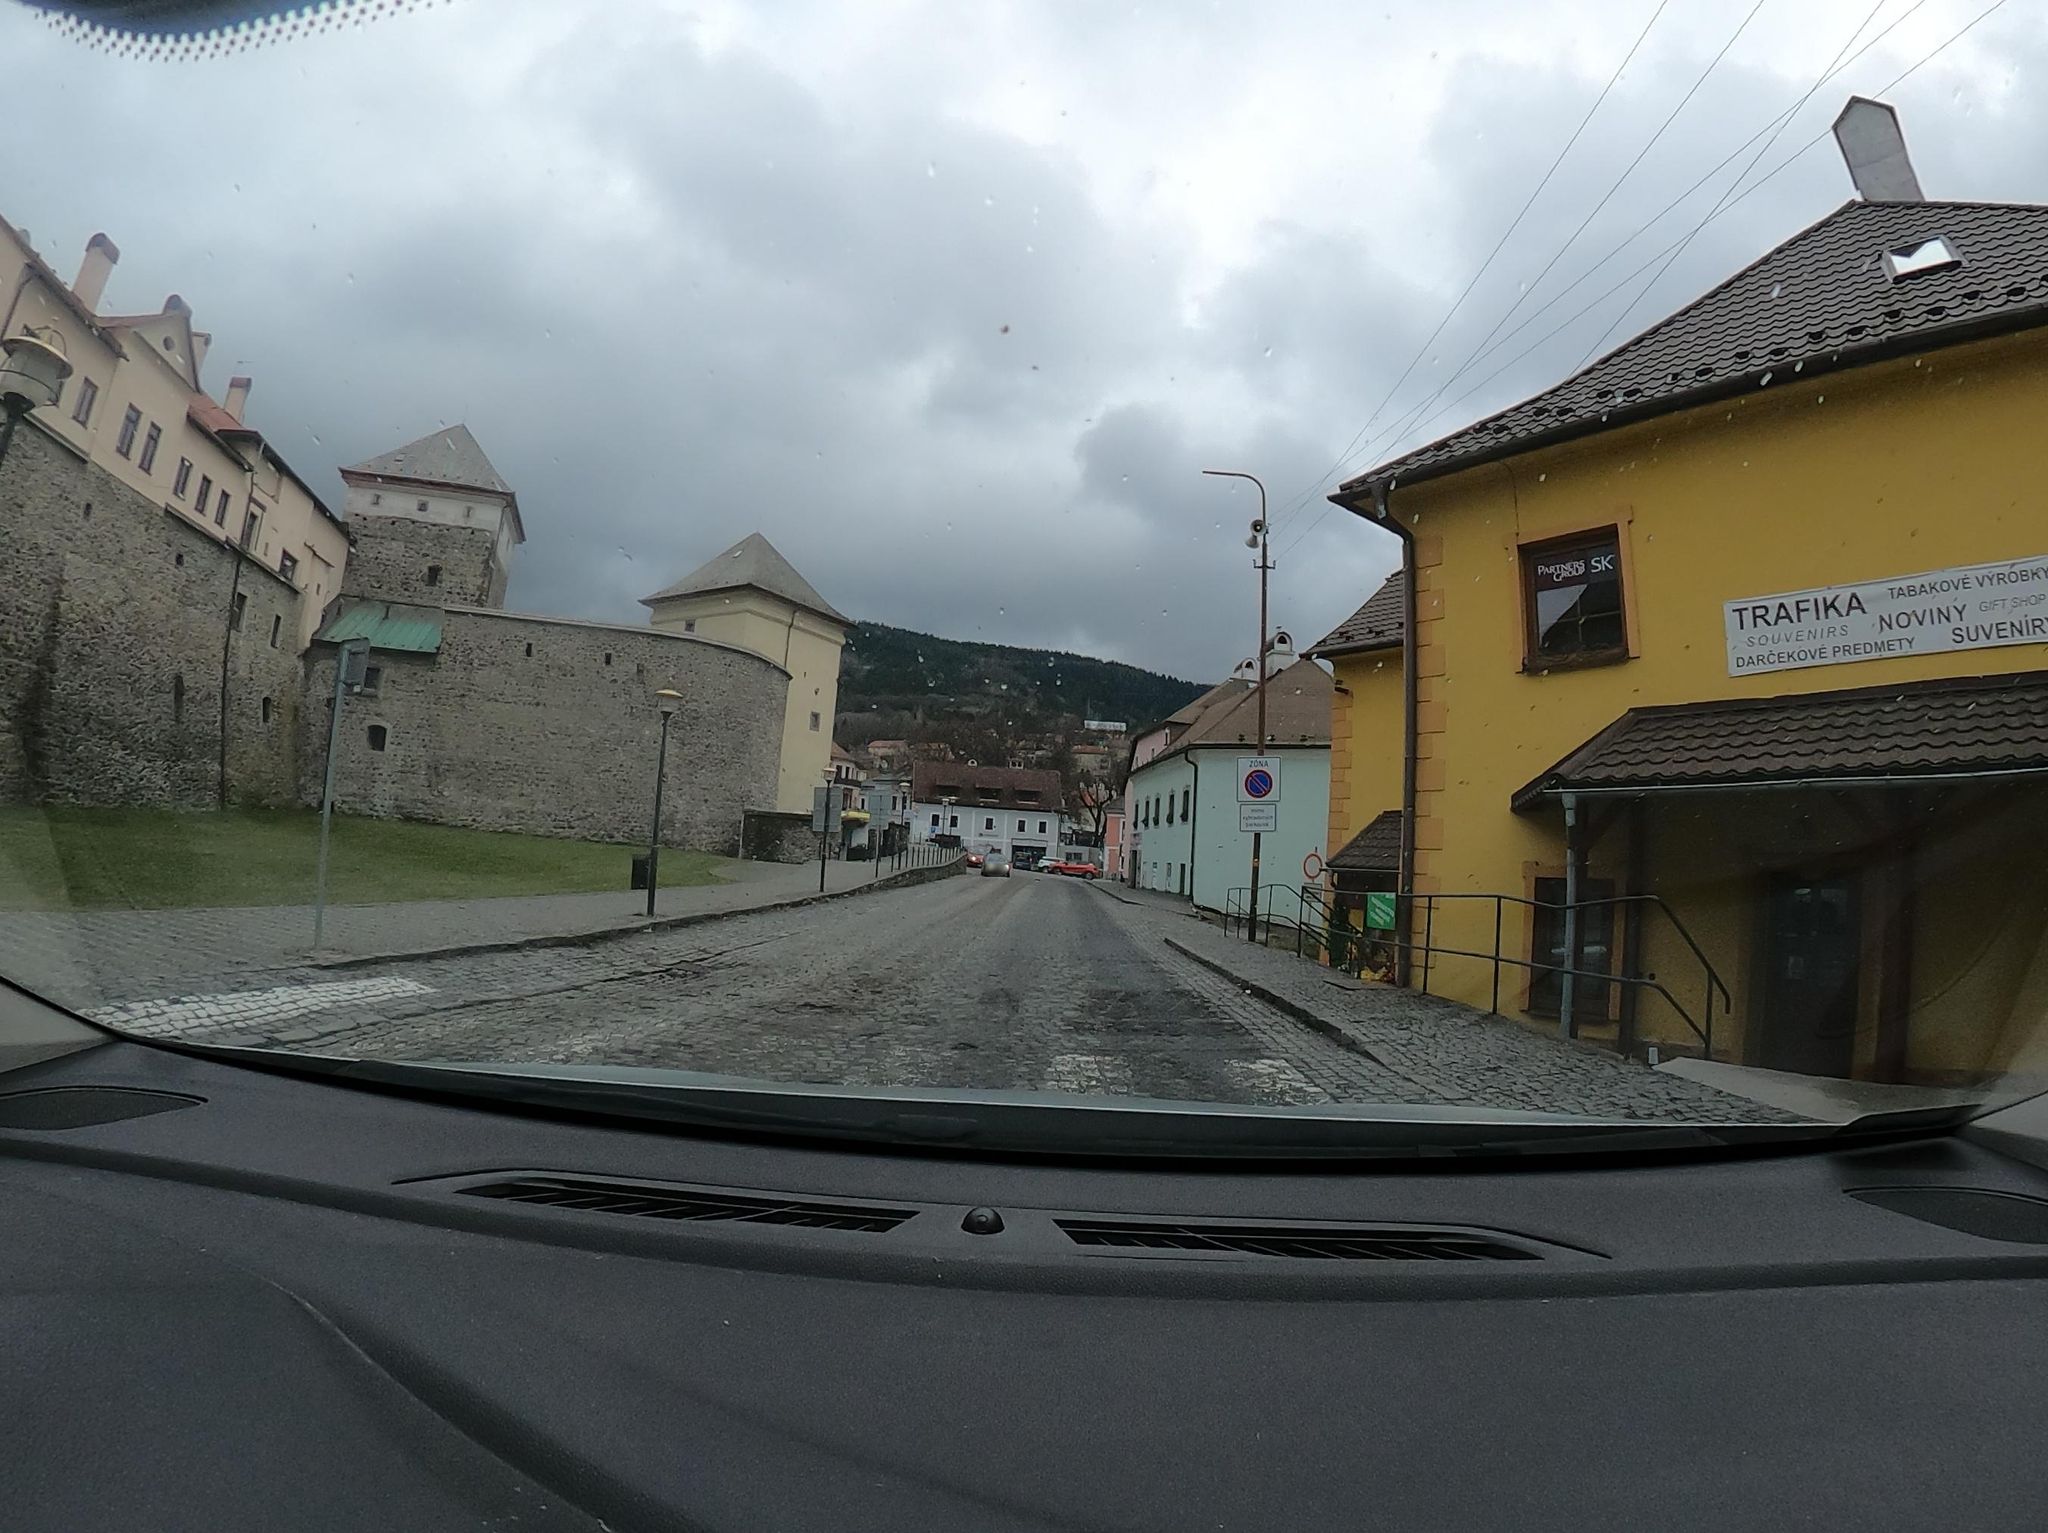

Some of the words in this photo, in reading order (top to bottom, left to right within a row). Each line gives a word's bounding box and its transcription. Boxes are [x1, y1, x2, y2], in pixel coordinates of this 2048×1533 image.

[1537, 560, 1585, 576] PARTNERS
[1591, 554, 1615, 573] SK
[1888, 574, 1972, 599] TABAKOVÉ
[1732, 592, 1867, 630] TRAFIKA
[1979, 598, 2008, 612] GIFT
[2011, 594, 2047, 609] SHOP
[1879, 603, 1967, 632] NOVINY
[1746, 624, 1849, 648] SOUVENIRS
[1736, 644, 1828, 668] DARČEKOVÉ
[1832, 637, 1915, 658] PREDMETY
